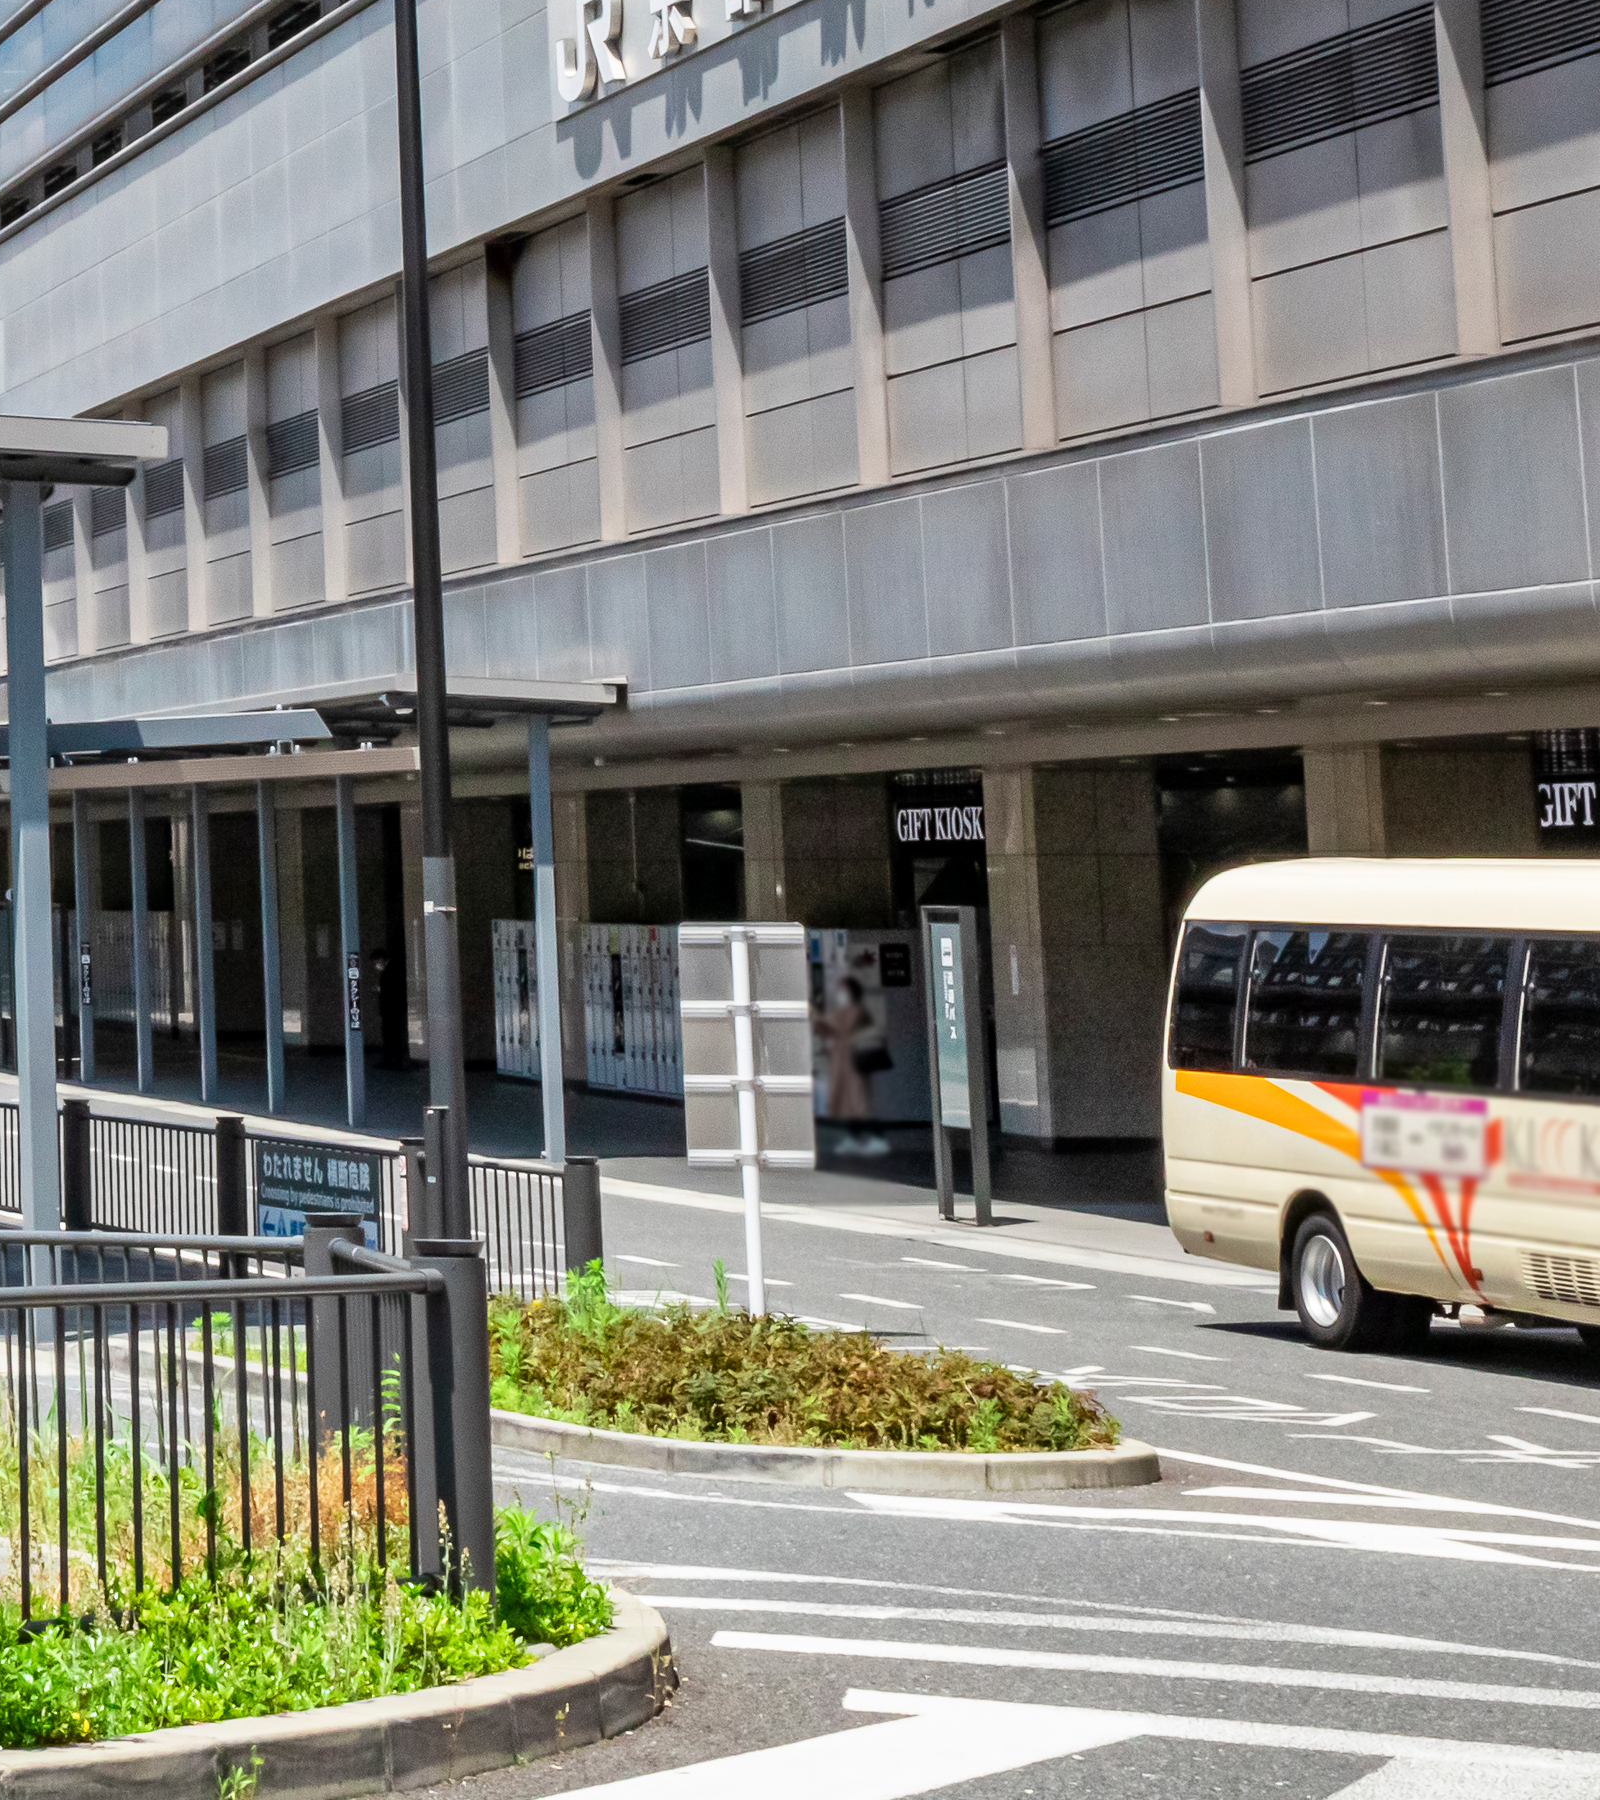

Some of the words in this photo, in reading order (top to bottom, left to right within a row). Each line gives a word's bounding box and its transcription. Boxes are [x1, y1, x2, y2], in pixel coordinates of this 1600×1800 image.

[1538, 782, 1597, 827] GIFT
[897, 808, 932, 842] GIFT
[933, 806, 985, 840] KIOSK
[263, 1151, 323, 1184] わたれません
